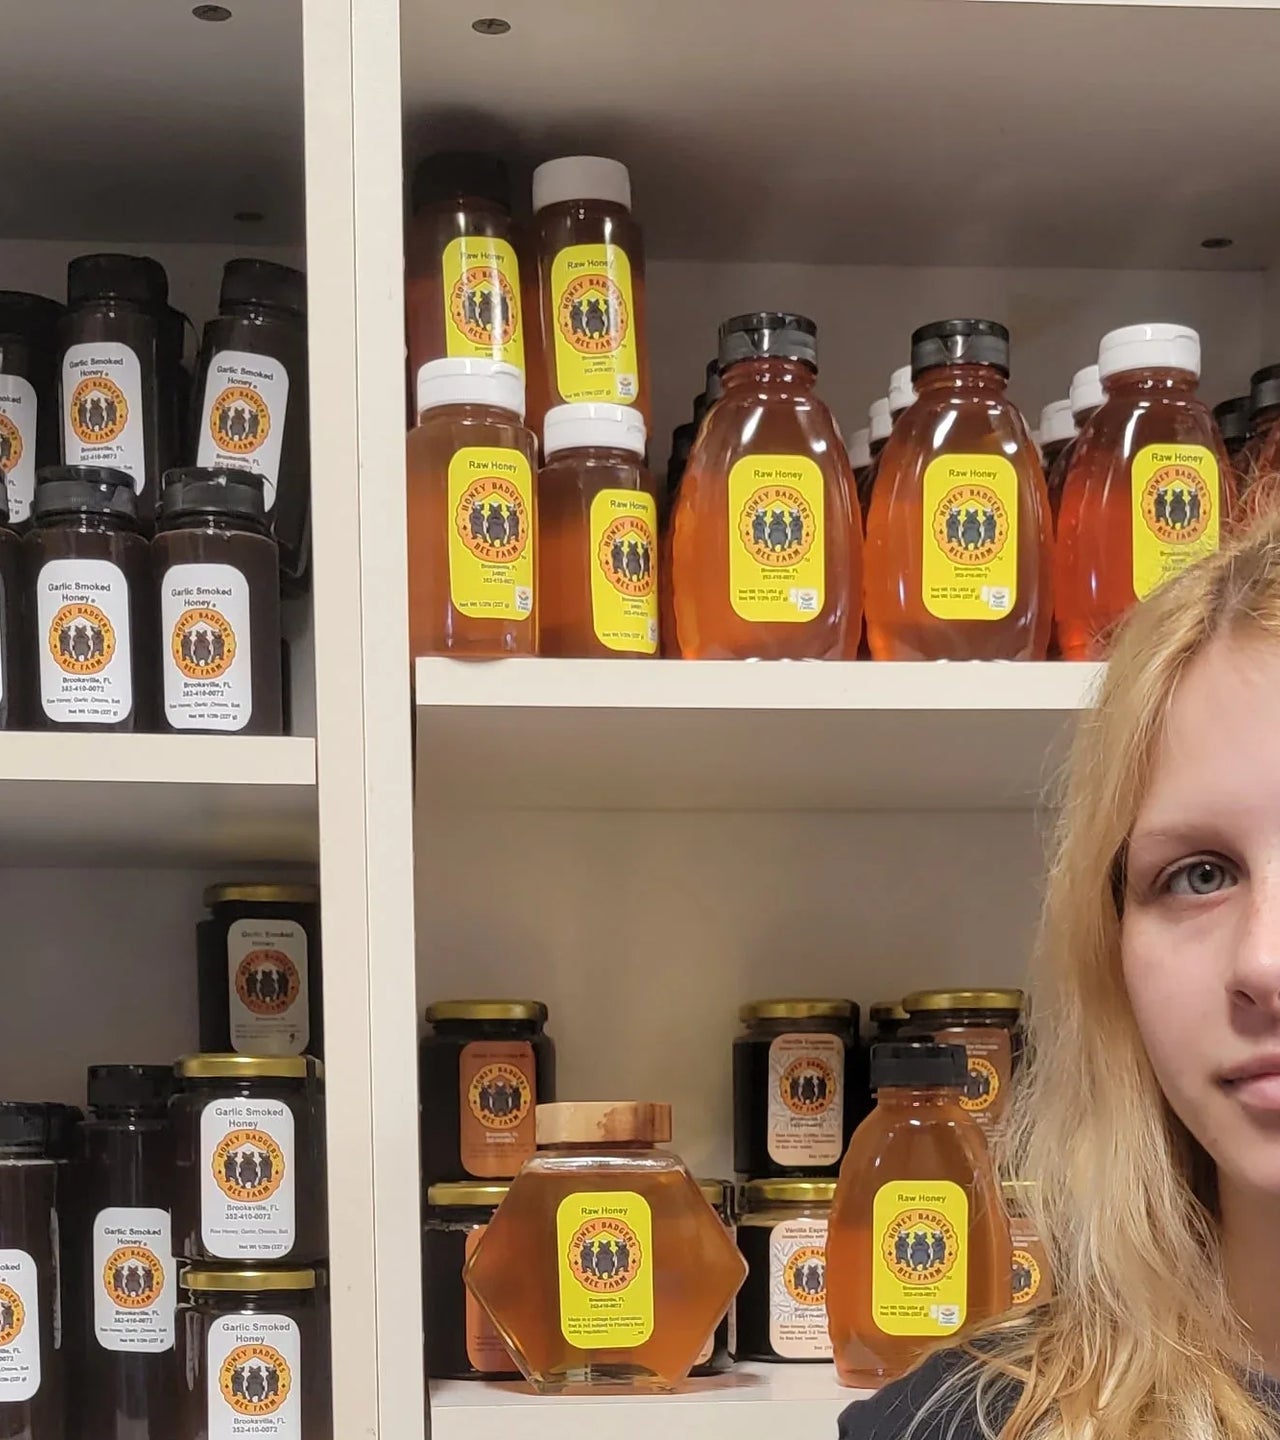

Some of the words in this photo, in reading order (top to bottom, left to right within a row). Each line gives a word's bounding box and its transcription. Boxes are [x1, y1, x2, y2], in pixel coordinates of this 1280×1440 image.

[1152, 453, 1172, 462] Raw
[1175, 454, 1203, 464] Honey
[469, 461, 489, 469] Raw
[491, 462, 517, 473] Honey
[754, 470, 775, 478] Raw
[776, 470, 802, 481] Honey
[949, 470, 968, 478] Raw
[970, 470, 996, 480] Honey
[48, 583, 72, 592] Garlic
[75, 583, 111, 592] Smoked
[172, 588, 195, 597] Garlic
[197, 587, 232, 596] Smoked
[62, 593, 89, 603] Honey
[184, 598, 211, 608] Honey
[215, 1108, 245, 1117] Garlic
[247, 1108, 283, 1117] Smoked
[229, 1119, 258, 1129] Honey
[898, 1194, 916, 1202] Raw
[919, 1194, 946, 1203] Honey
[581, 1207, 598, 1215] Raw
[601, 1207, 627, 1216] Honey
[222, 1322, 248, 1331] Garlic
[252, 1323, 290, 1331] Smoked
[236, 1334, 265, 1344] Honey
